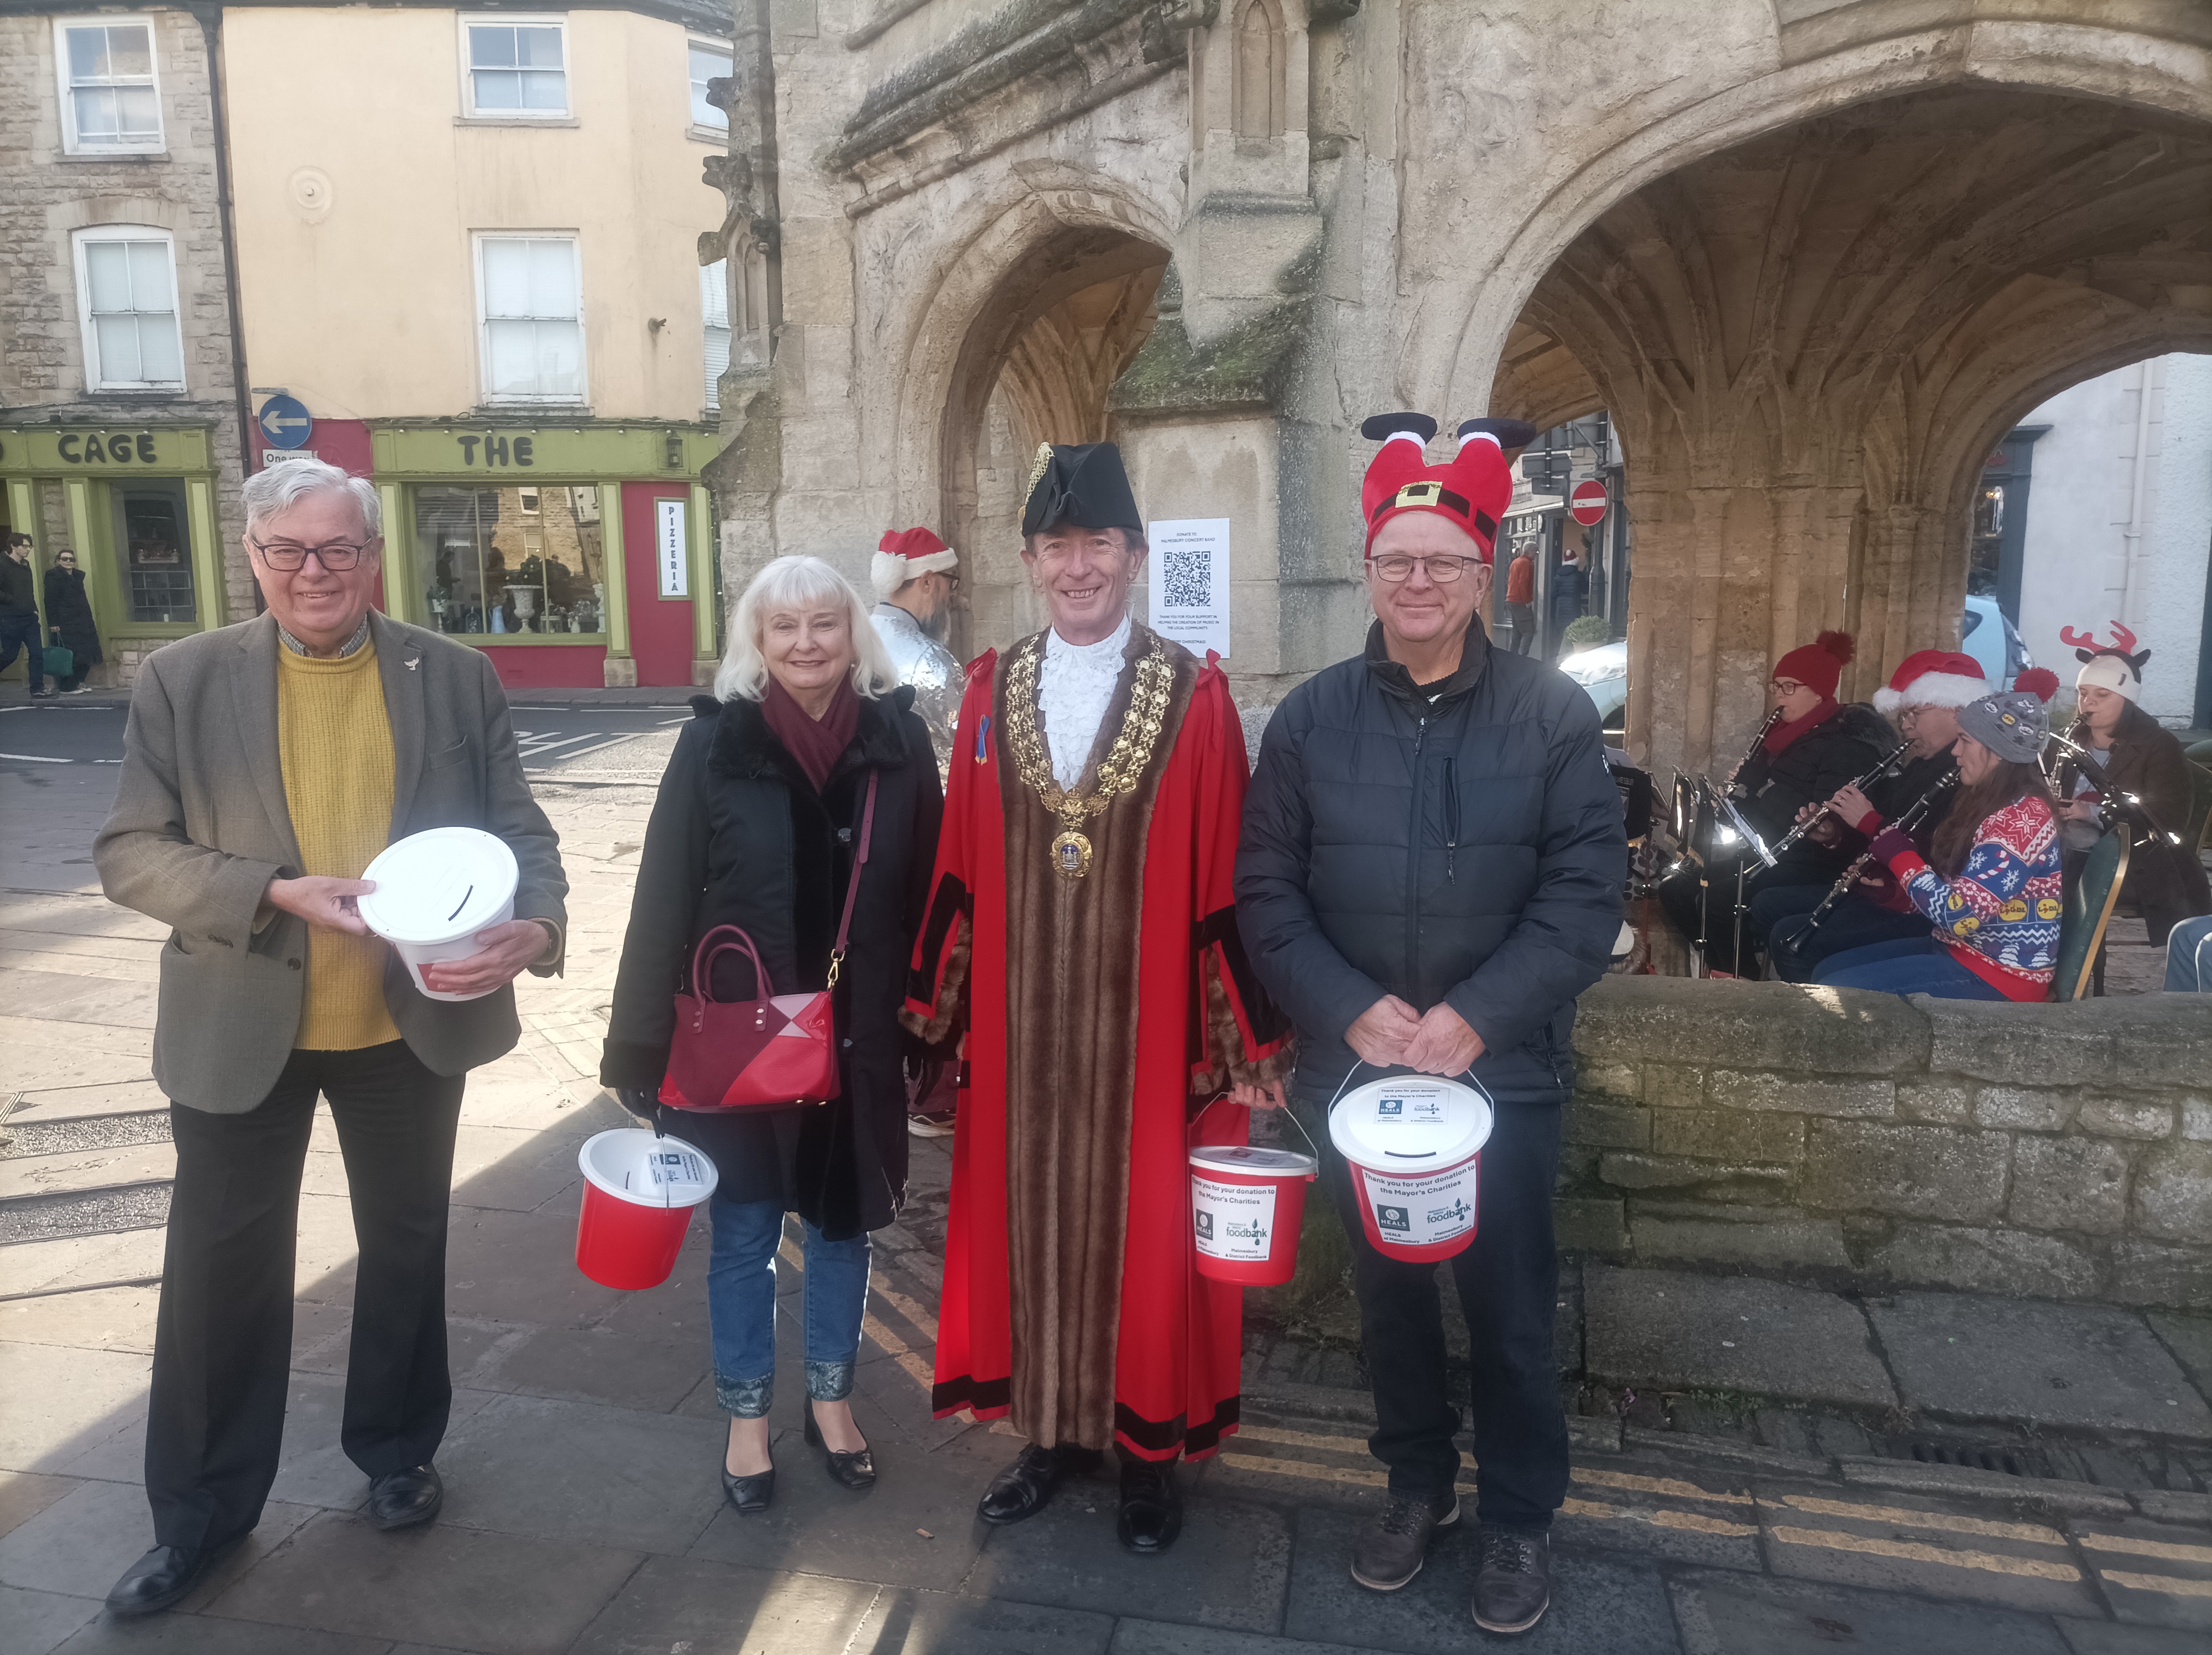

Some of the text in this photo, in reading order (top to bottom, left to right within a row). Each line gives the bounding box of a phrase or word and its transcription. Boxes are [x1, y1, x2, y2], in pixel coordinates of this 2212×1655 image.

[58, 434, 157, 464] CAGE
[457, 435, 534, 467] THE
[267, 454, 286, 462] One
[669, 507, 678, 591] PIZZERIA
[1364, 1172, 1386, 1184] Thank
[1434, 1169, 1467, 1183] donation
[1427, 1180, 1461, 1194] Charities
[1206, 1193, 1228, 1203] Mayor's
[1427, 1203, 1471, 1224] foodbank
[1197, 1225, 1212, 1235] HEALS
[1227, 1227, 1267, 1237] foodbank
